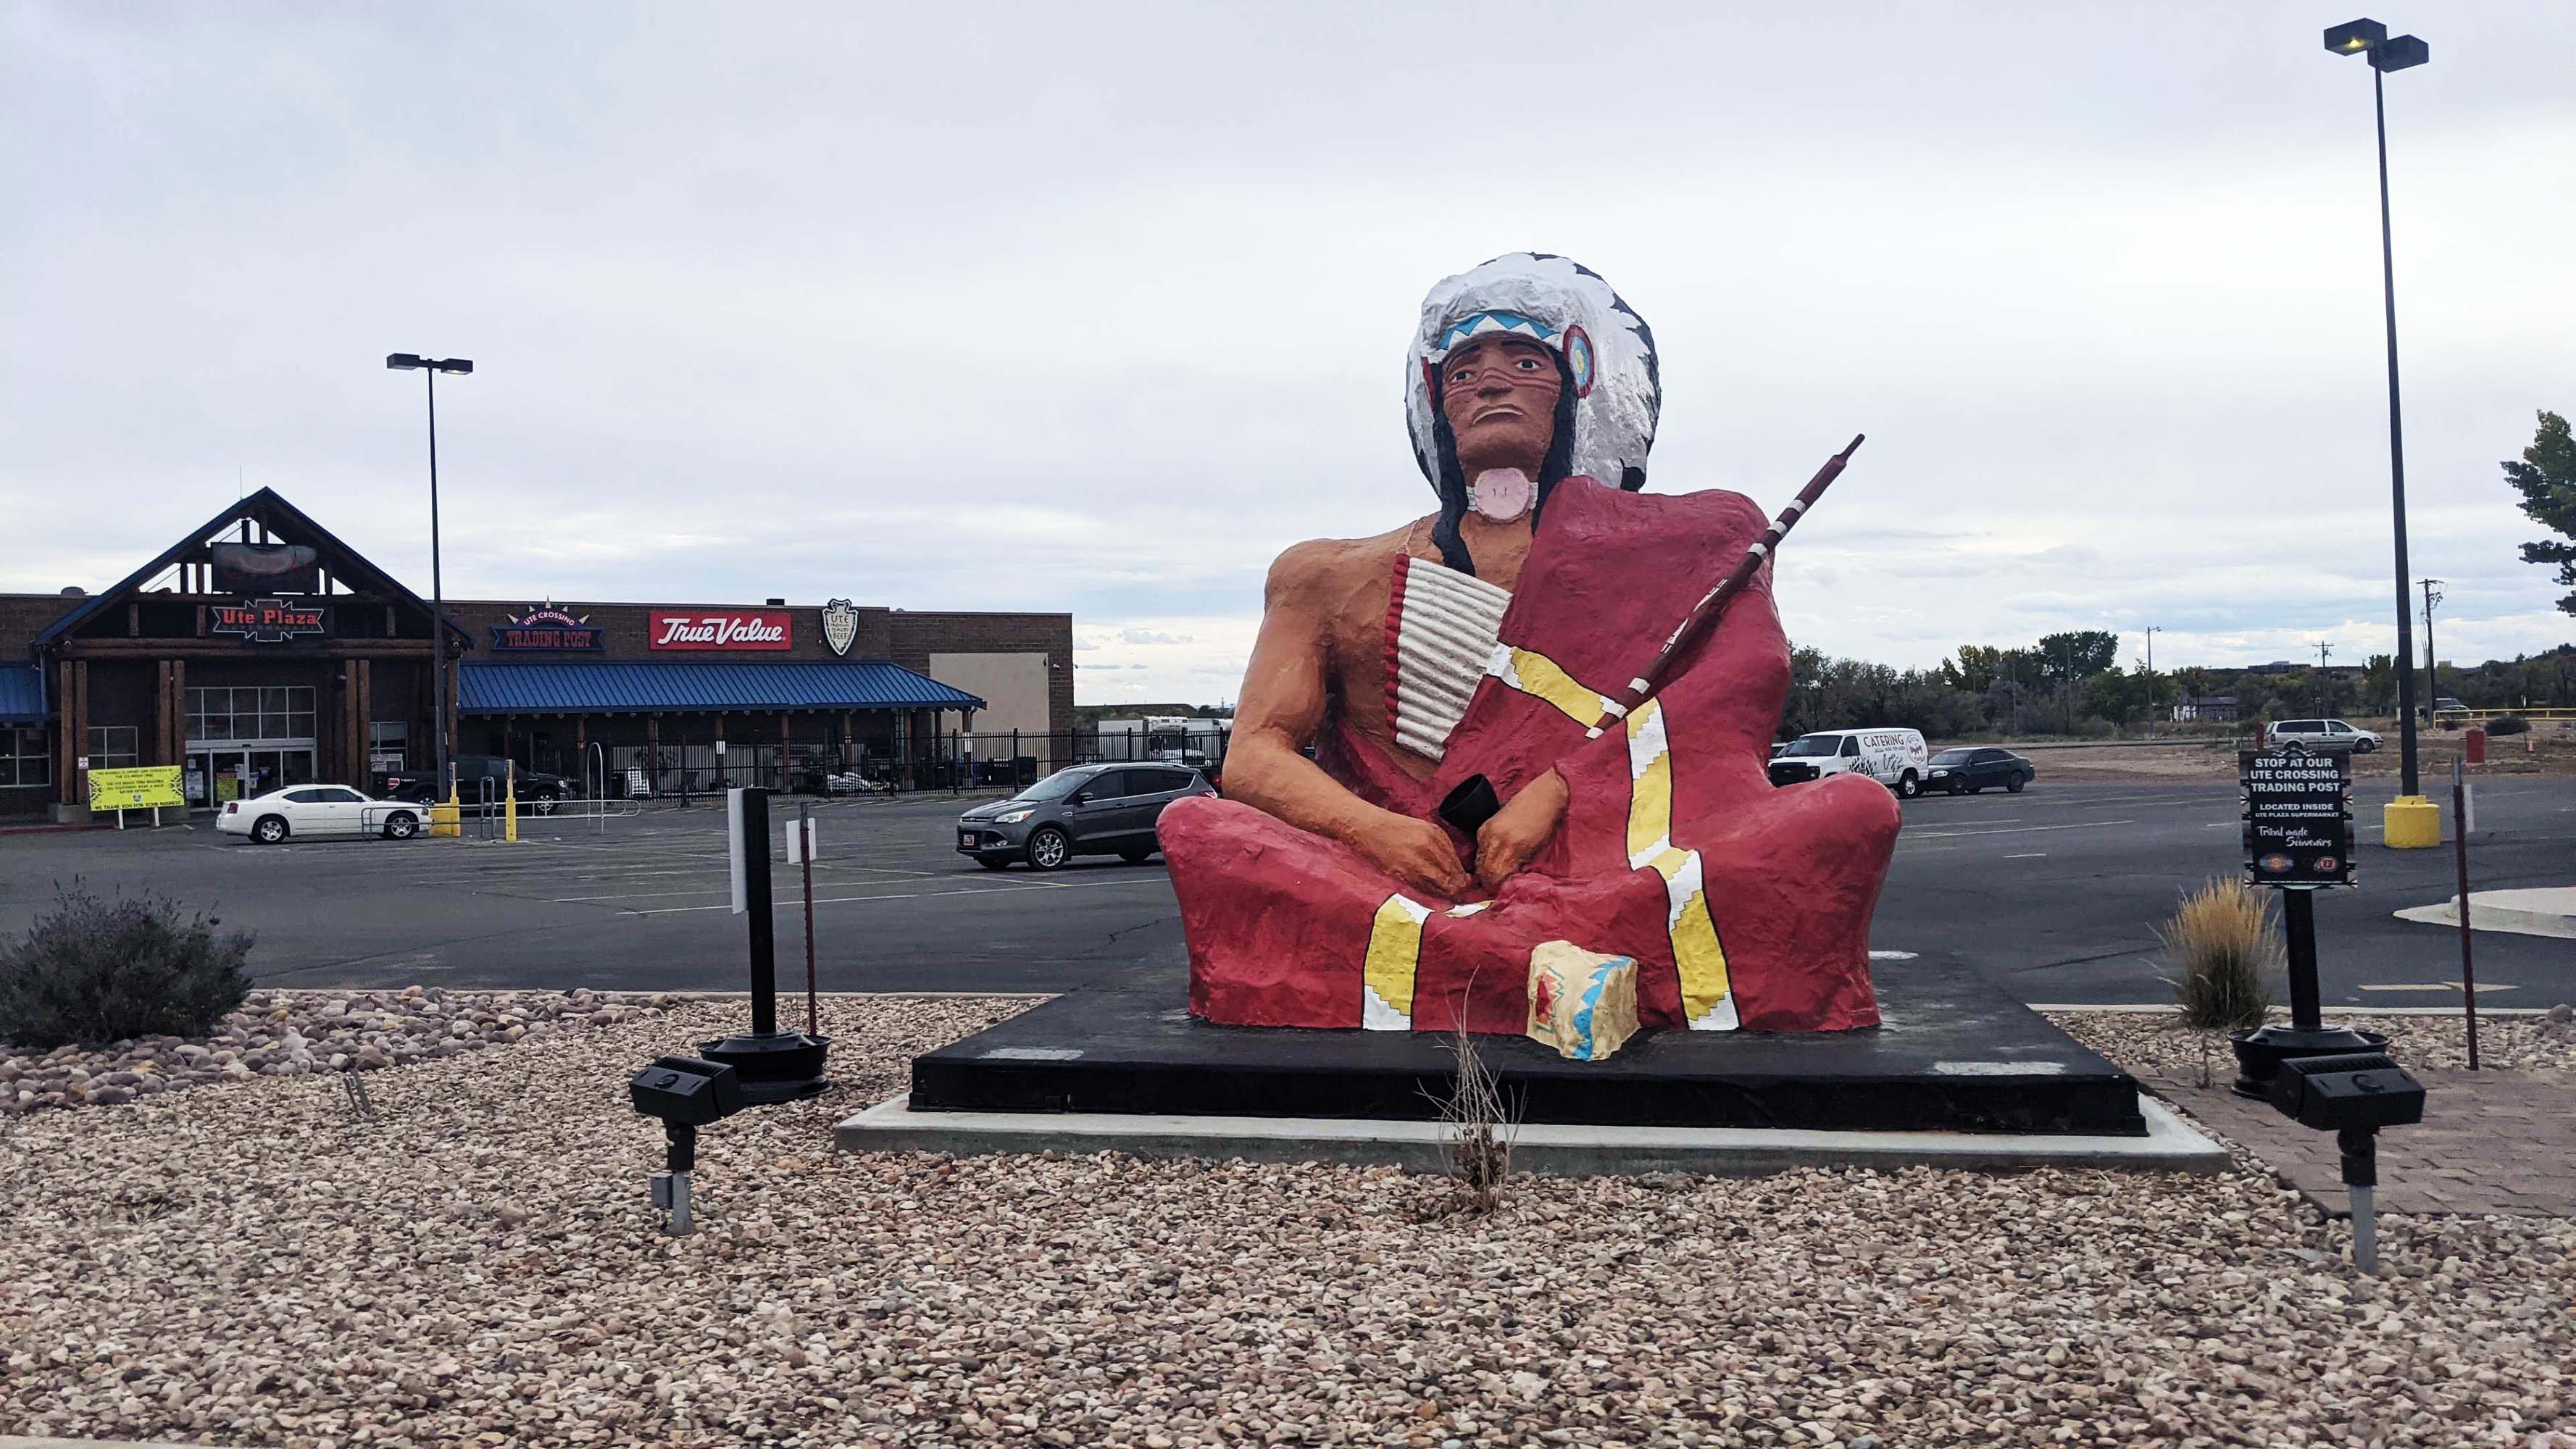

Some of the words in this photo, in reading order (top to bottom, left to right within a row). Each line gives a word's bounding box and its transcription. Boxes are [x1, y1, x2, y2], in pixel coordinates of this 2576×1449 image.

[222, 609, 255, 625] Ute
[263, 609, 317, 625] Plaza
[524, 614, 538, 626] UTE
[538, 611, 575, 626] CROSSING
[507, 630, 560, 648] TRADING
[563, 630, 592, 648] POST
[1864, 735, 1904, 747] CATERING
[2255, 758, 2286, 768] STOP
[2290, 758, 2304, 768] AT
[2306, 758, 2333, 768] OUR
[2250, 770, 2273, 780] UTE
[2275, 770, 2339, 780] CROSSING
[2251, 782, 2306, 793] TRADING
[2309, 782, 2341, 792] POST
[2256, 825, 2283, 837] Tribal
[2285, 827, 2308, 836] made
[2285, 837, 2332, 847] Souvenirs
